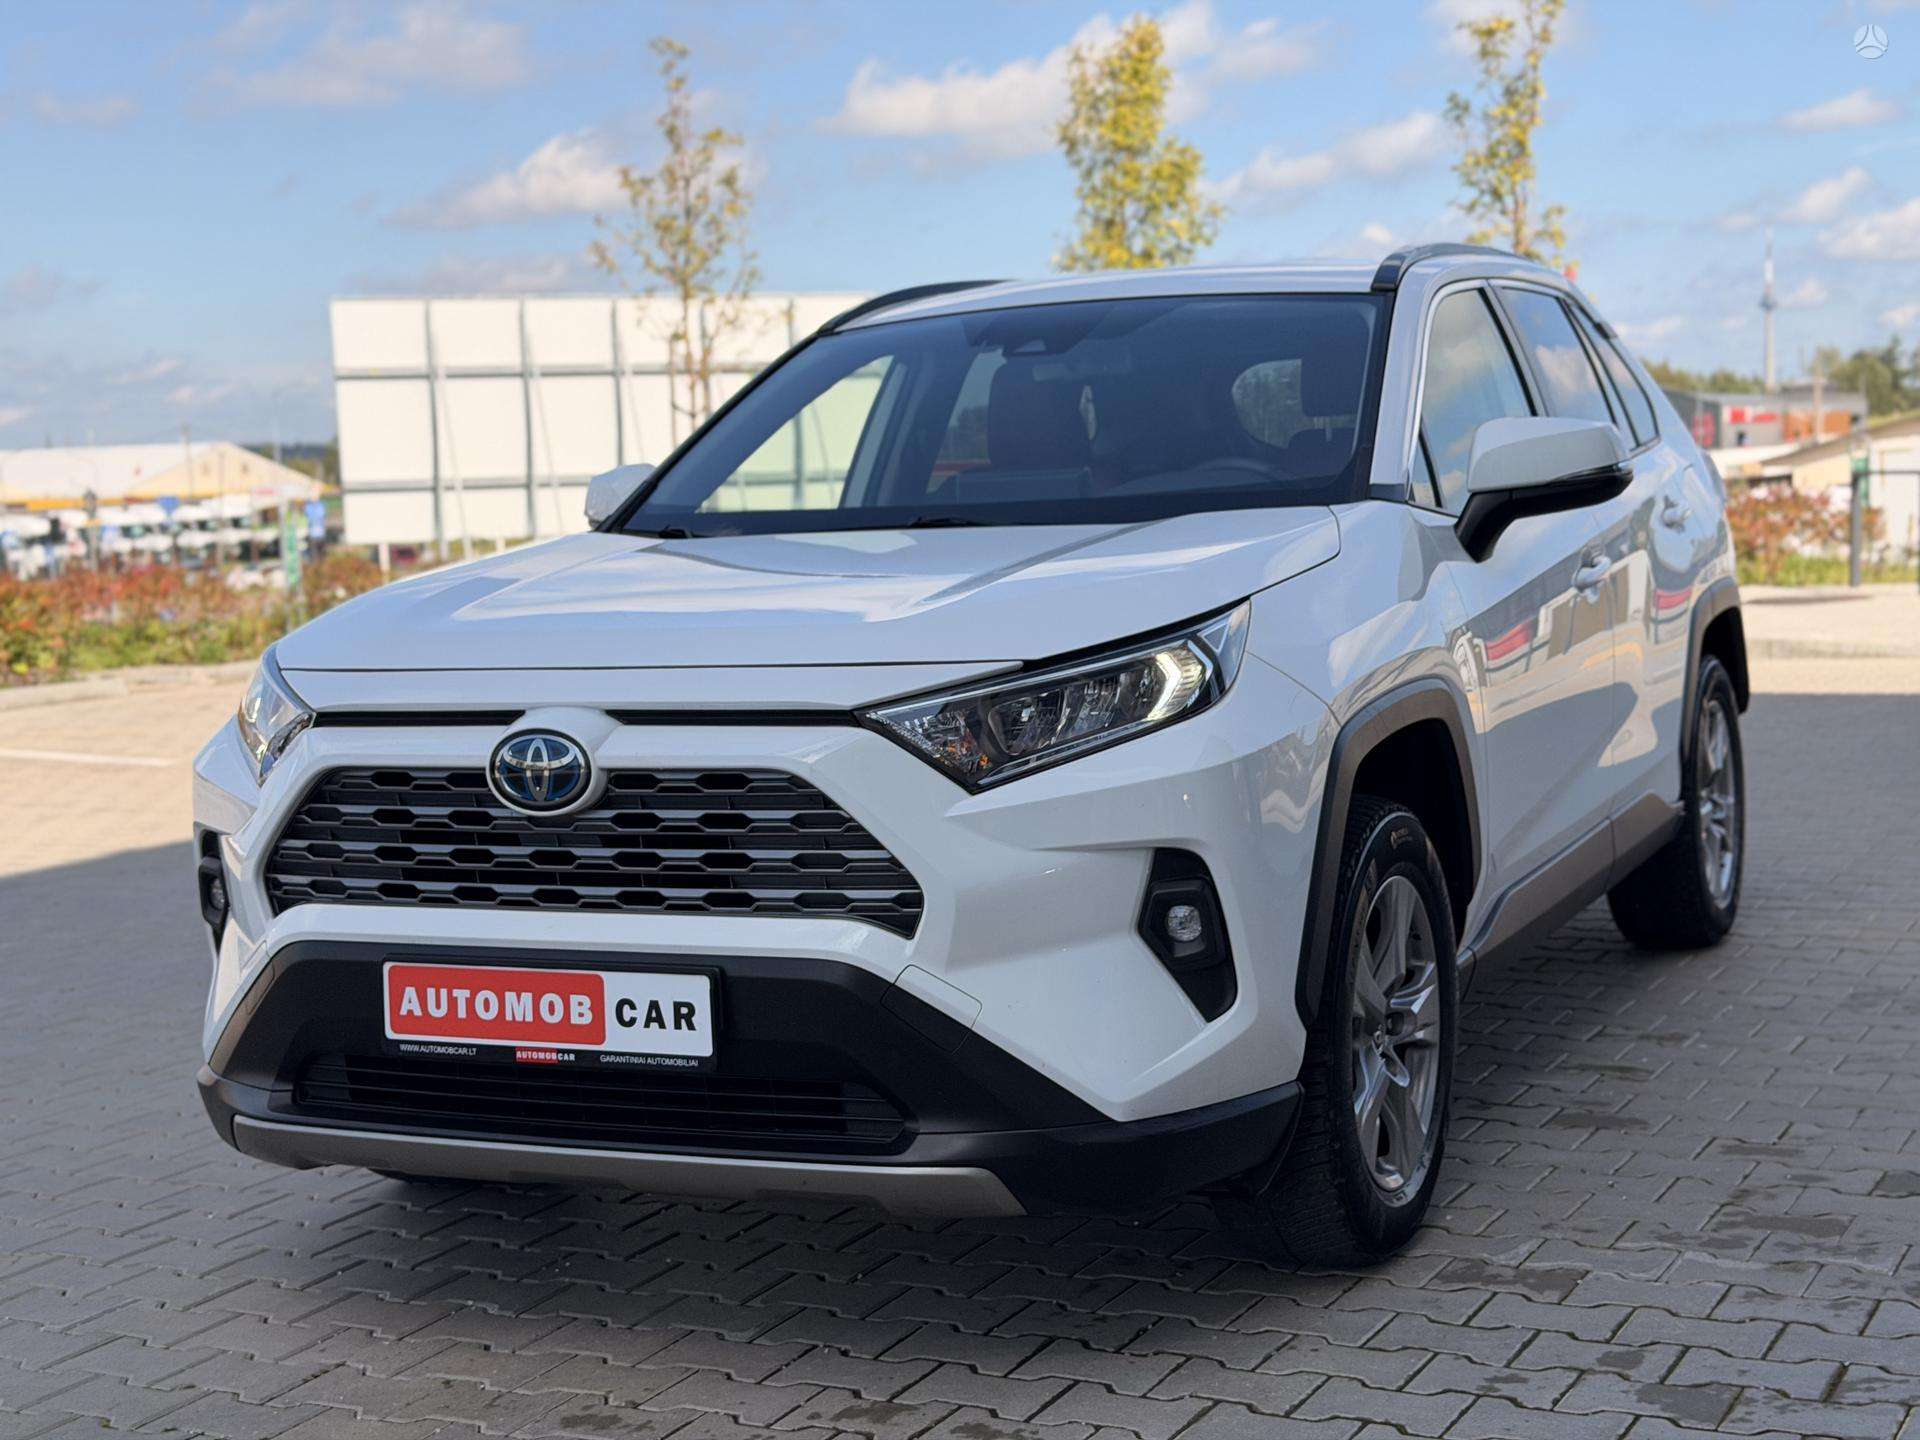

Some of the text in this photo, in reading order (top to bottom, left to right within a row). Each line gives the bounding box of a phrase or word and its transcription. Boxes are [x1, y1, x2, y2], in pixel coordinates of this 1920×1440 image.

[399, 986, 696, 1031] AUTOMOB CAR
[399, 1043, 477, 1057] WWW.AUTOMOBCAR.LT
[600, 1054, 699, 1067] GARANTINIAI AUTOMOBILIAI
